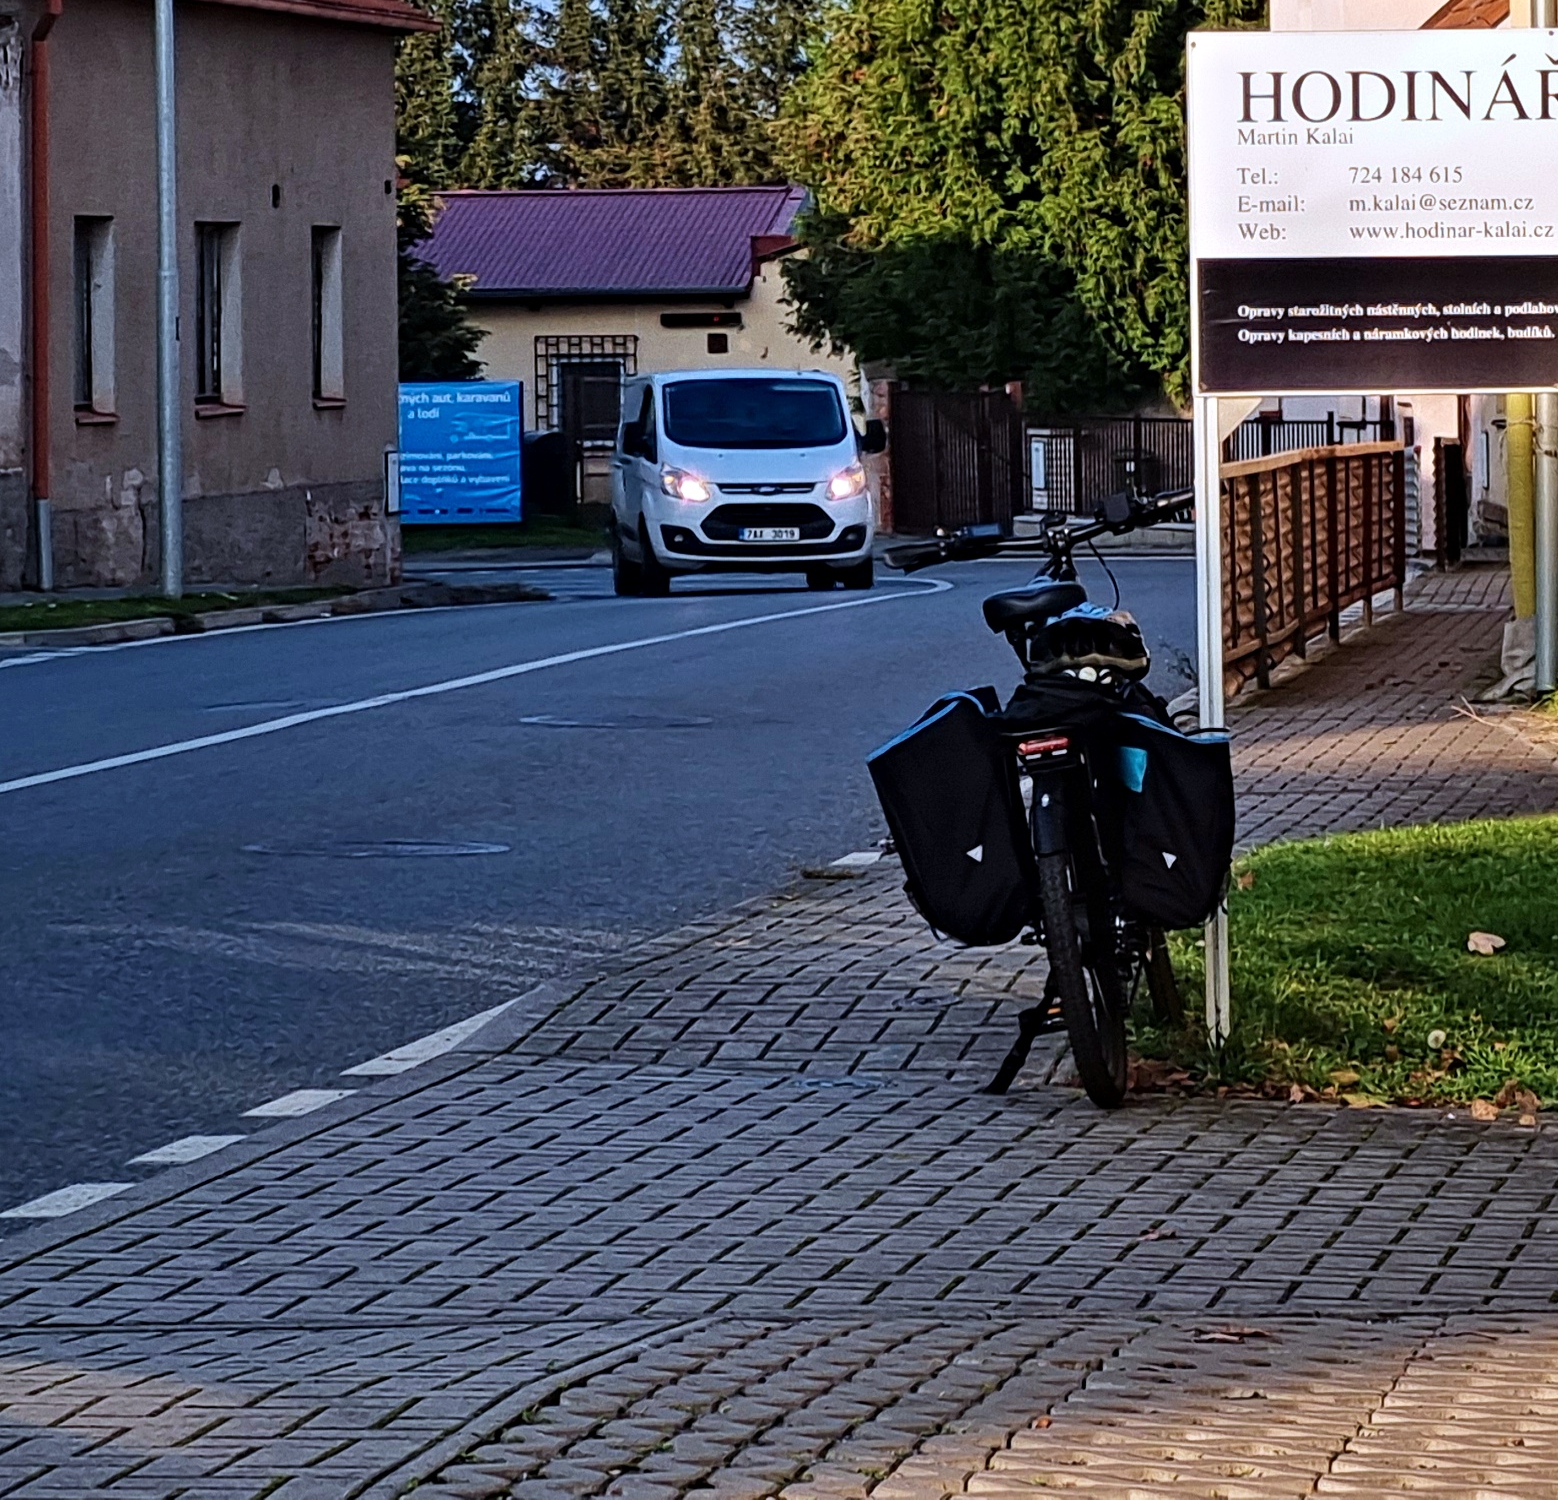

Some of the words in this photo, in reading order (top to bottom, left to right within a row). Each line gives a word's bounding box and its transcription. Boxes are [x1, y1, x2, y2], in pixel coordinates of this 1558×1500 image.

[1237, 128, 1298, 146] Martin
[1306, 127, 1354, 145] Kalai
[1237, 167, 1278, 185] Tel.:
[1349, 166, 1382, 184] 724
[1392, 166, 1423, 184] 184
[1429, 166, 1463, 184] 615
[1238, 194, 1305, 213] E-mail:
[1349, 193, 1535, 212] m.kalai@seznam.cz
[1238, 222, 1287, 240] Web:
[1349, 220, 1555, 239] www.hodinar-kalai.cz
[1237, 304, 1285, 320] Opravy
[1288, 303, 1364, 319] starožitných
[1366, 302, 1441, 319] nástěnných,
[1442, 302, 1492, 316] stolních
[1493, 305, 1502, 315] a
[1237, 328, 1286, 344] Opravy
[1287, 327, 1351, 344] kapesních
[1352, 330, 1361, 341] a
[1363, 326, 1449, 343] náramkových
[1507, 324, 1556, 339] budíků.
[456, 390, 512, 403] karavanů
[417, 407, 440, 419] lodí
